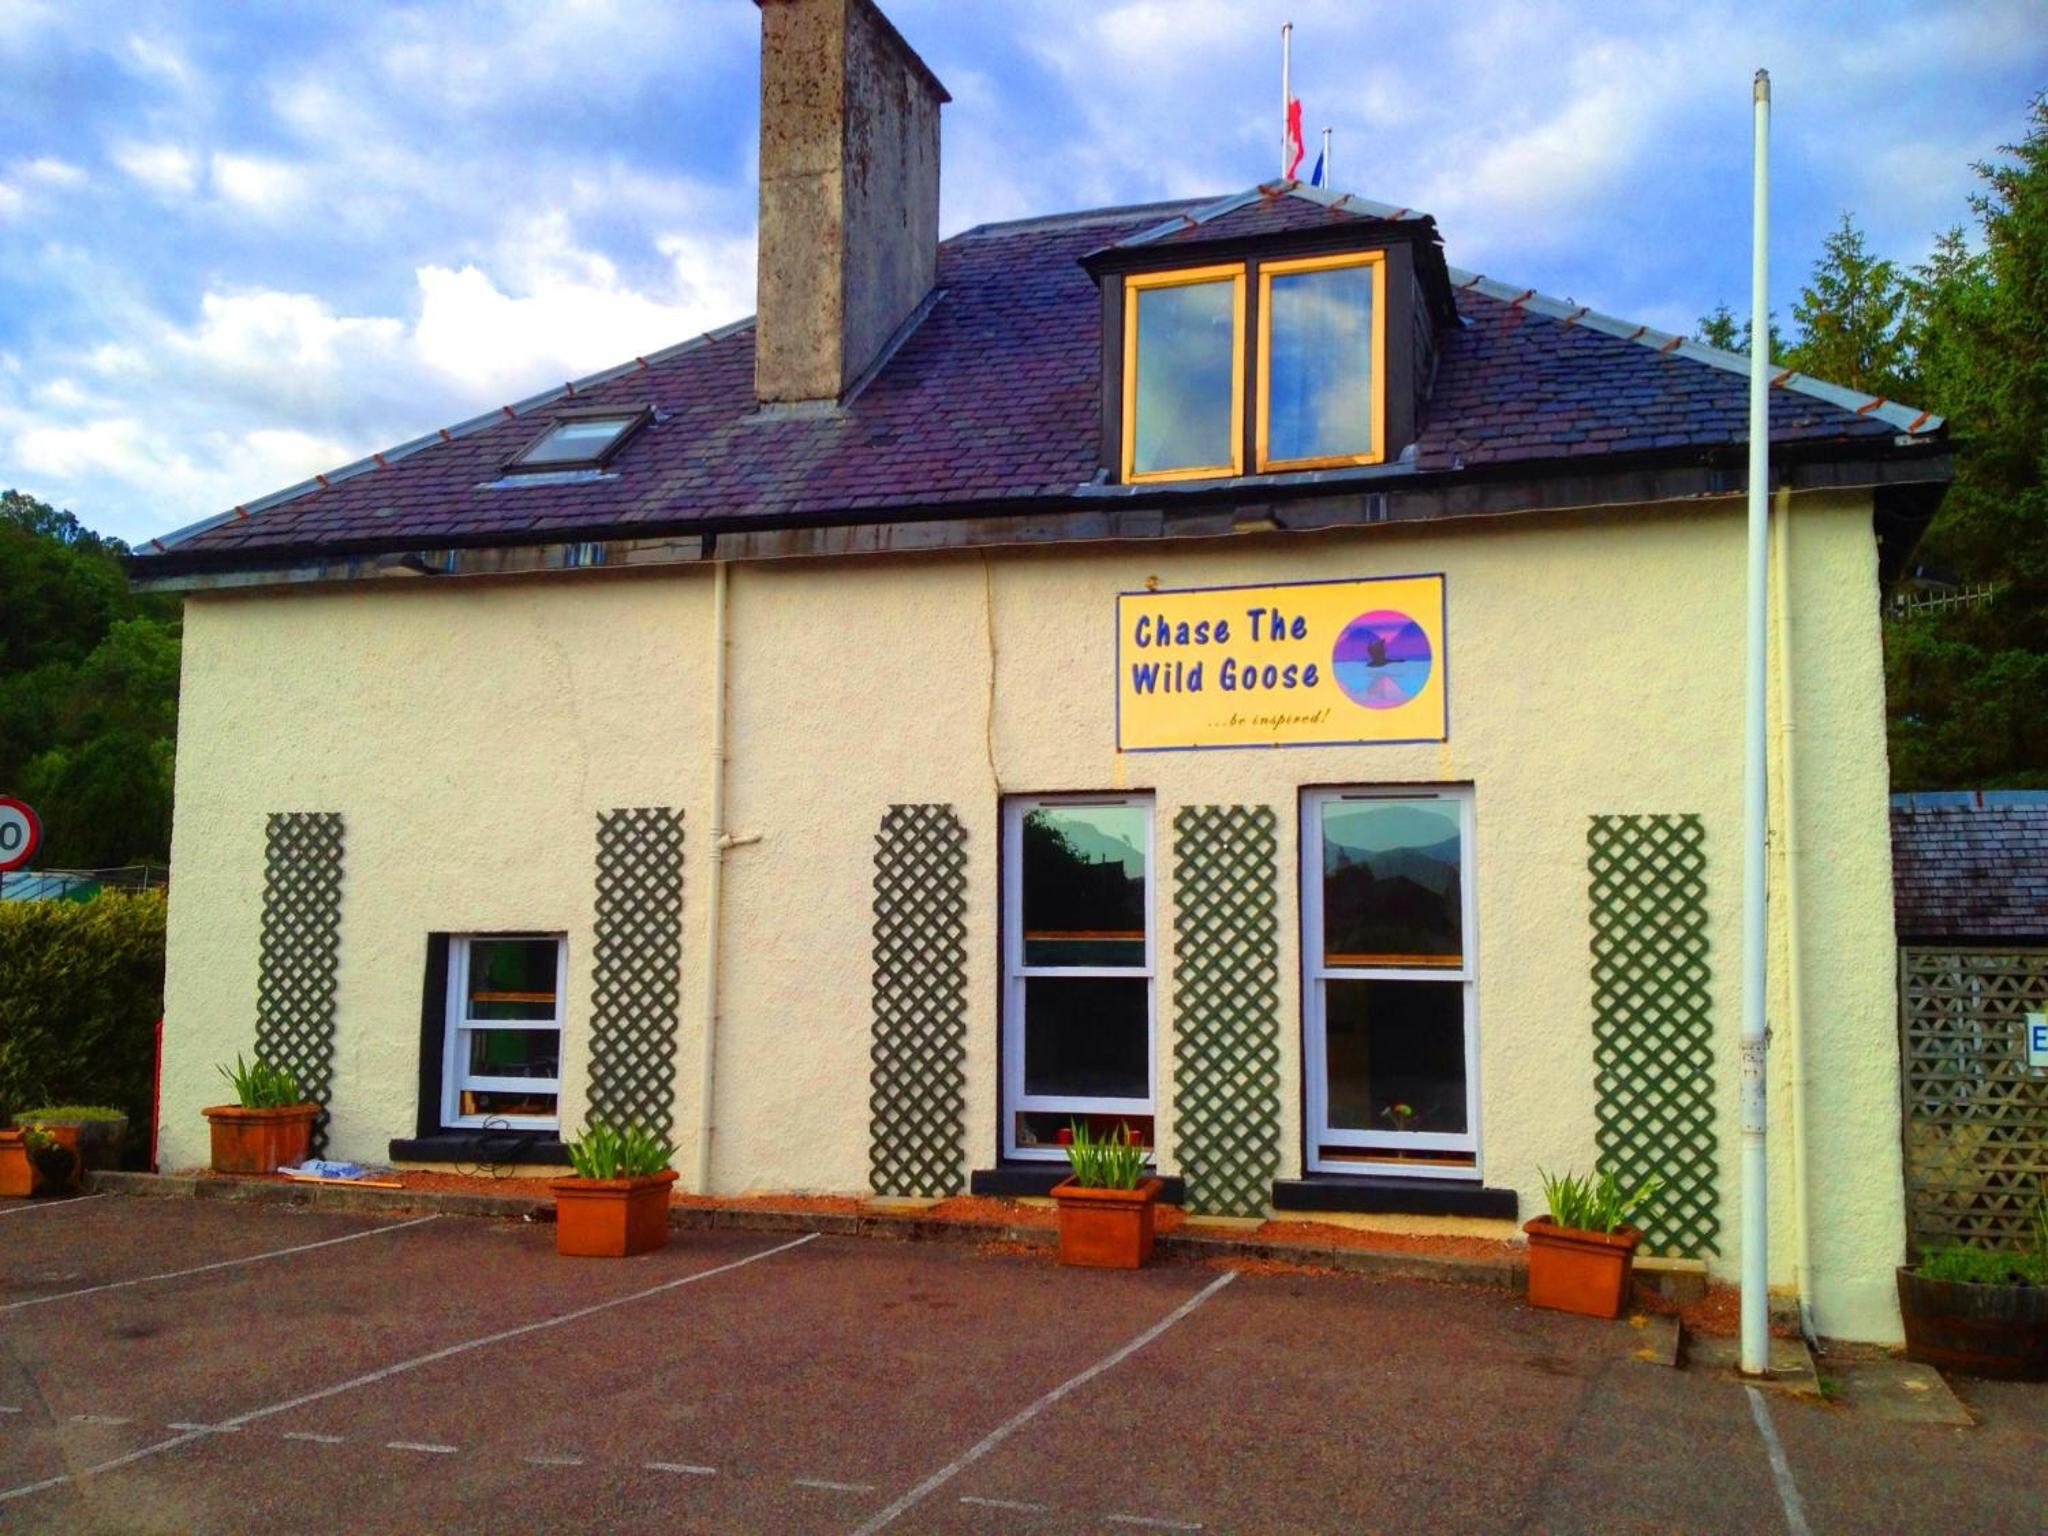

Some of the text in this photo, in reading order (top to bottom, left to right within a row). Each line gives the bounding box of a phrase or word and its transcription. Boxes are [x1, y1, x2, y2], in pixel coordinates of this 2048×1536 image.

[1134, 607, 1307, 648] Chase The
[1132, 656, 1319, 695] Wild Goose
[1252, 706, 1332, 731] inspired!
